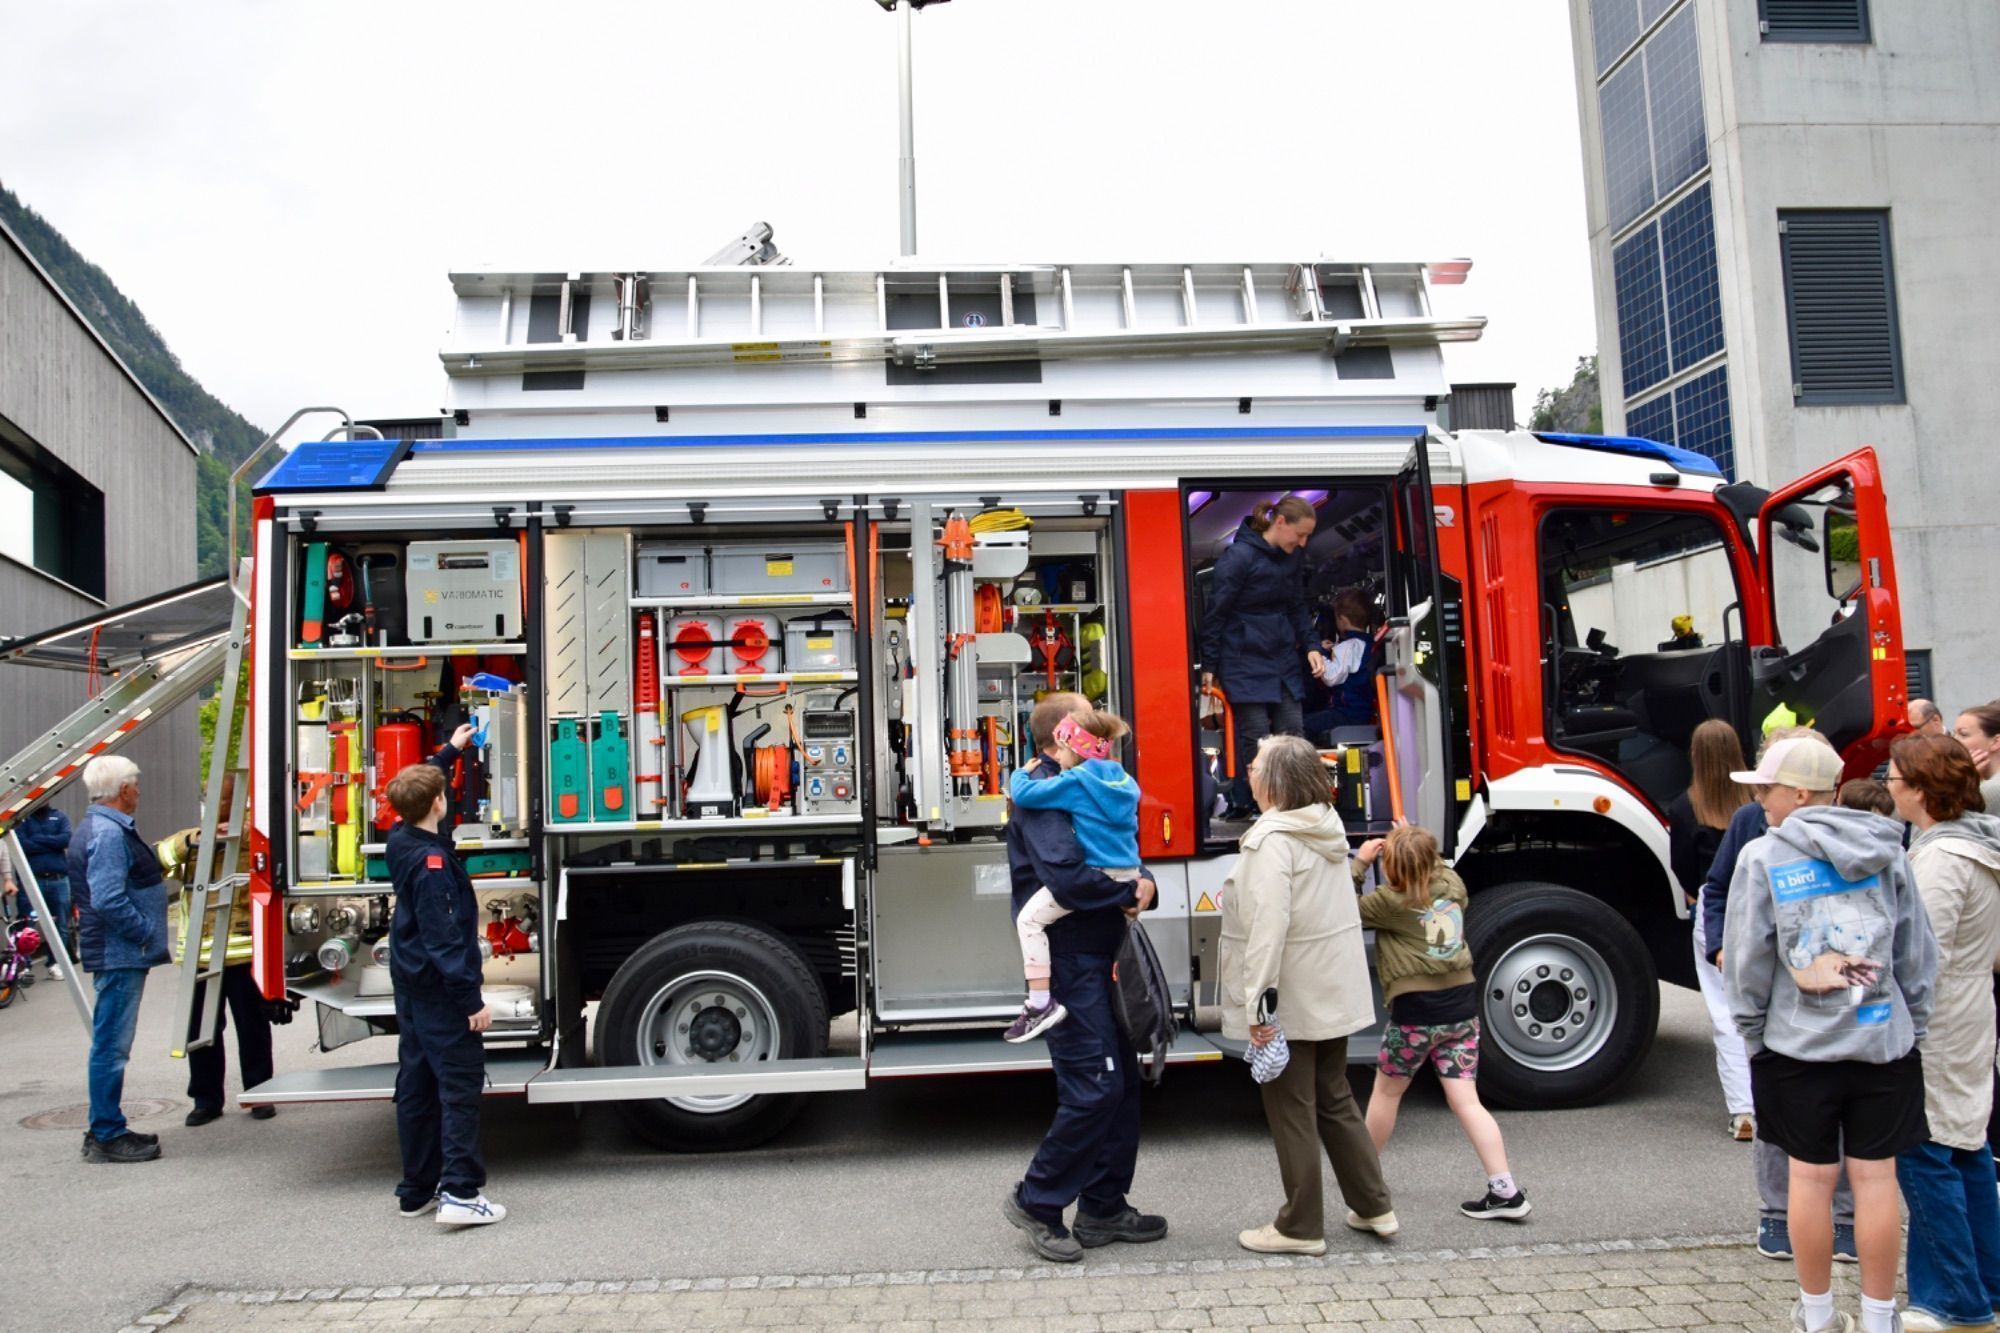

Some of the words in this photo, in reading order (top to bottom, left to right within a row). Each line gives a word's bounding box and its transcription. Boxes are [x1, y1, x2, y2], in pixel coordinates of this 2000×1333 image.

[441, 589, 503, 600] VARIOMATIC
[1777, 879, 1785, 889] a
[1787, 869, 1815, 887] bird
